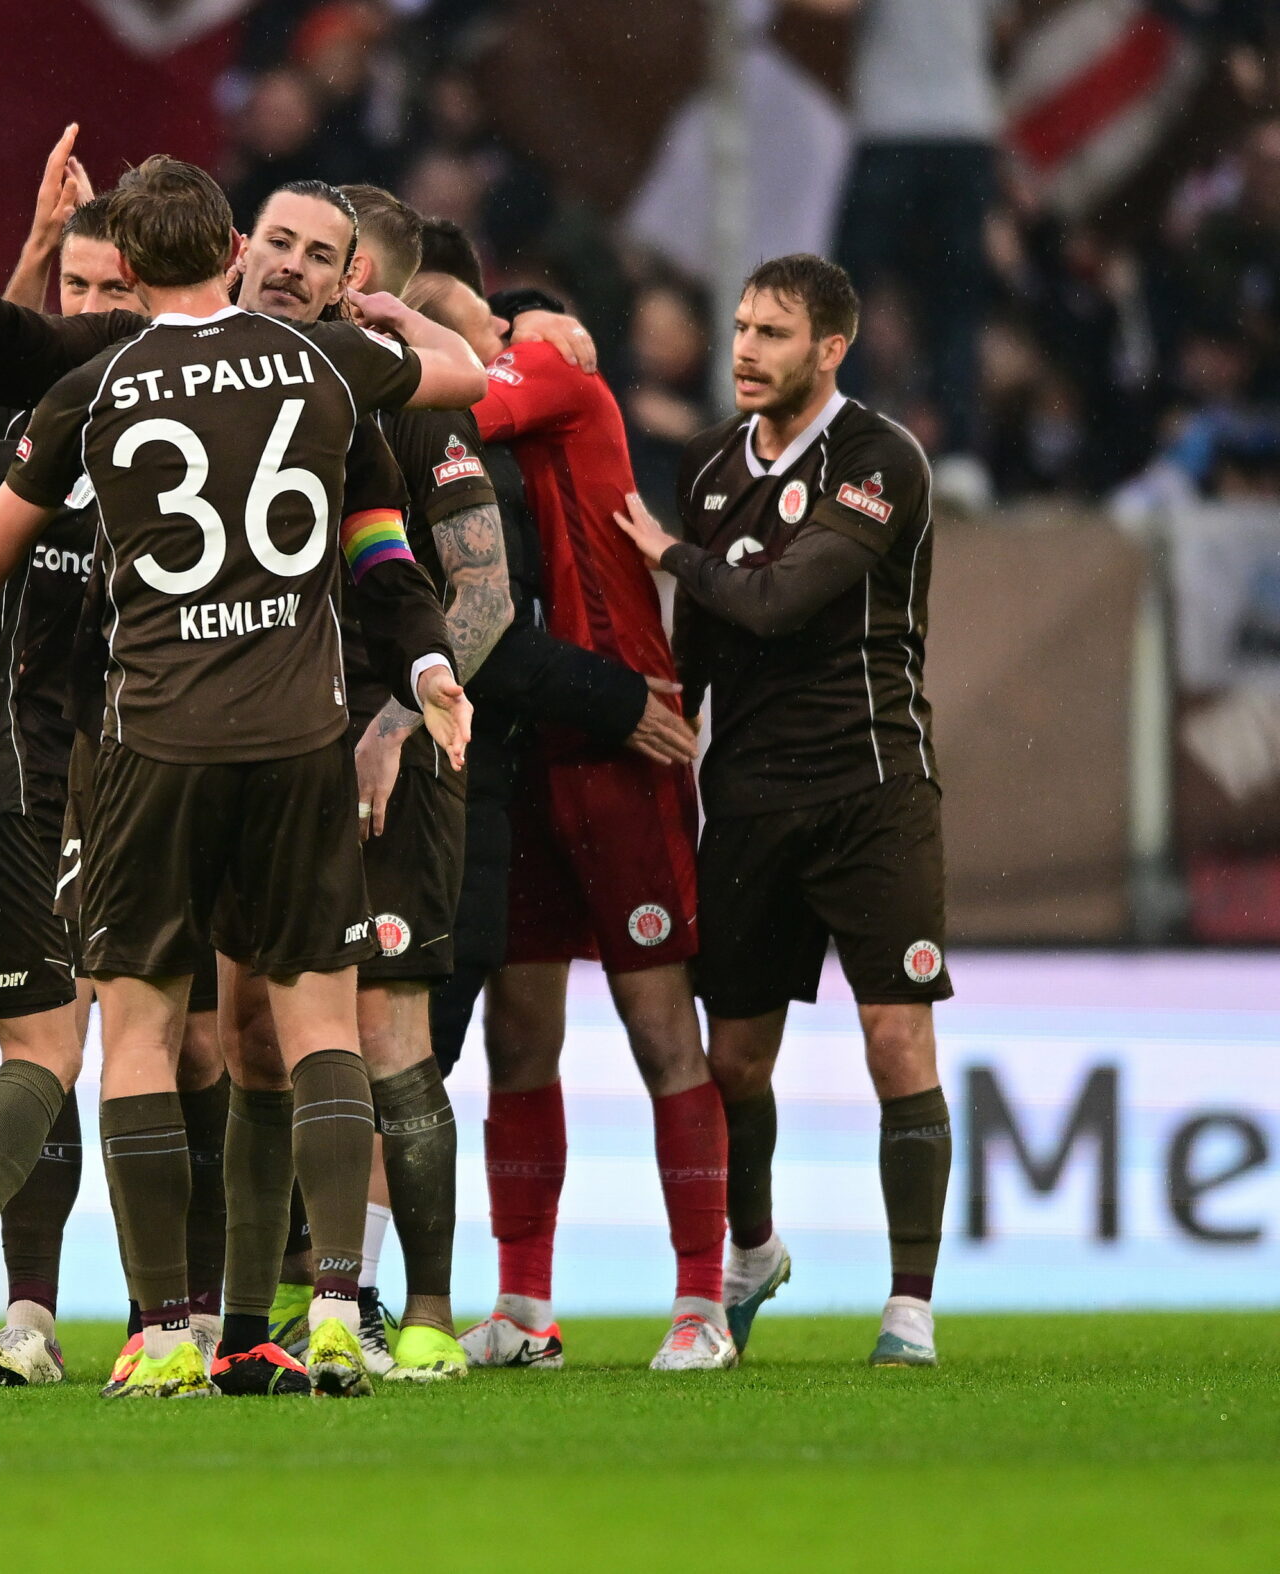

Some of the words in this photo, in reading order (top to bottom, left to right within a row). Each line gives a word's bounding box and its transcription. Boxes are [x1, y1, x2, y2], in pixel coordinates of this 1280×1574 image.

[111, 369, 173, 409] ST.
[181, 351, 315, 397] PAULI
[440, 461, 480, 480] ASTRA
[112, 399, 329, 595] 36
[842, 489, 886, 518] ASTRA
[180, 593, 301, 640] KEMLEIN
